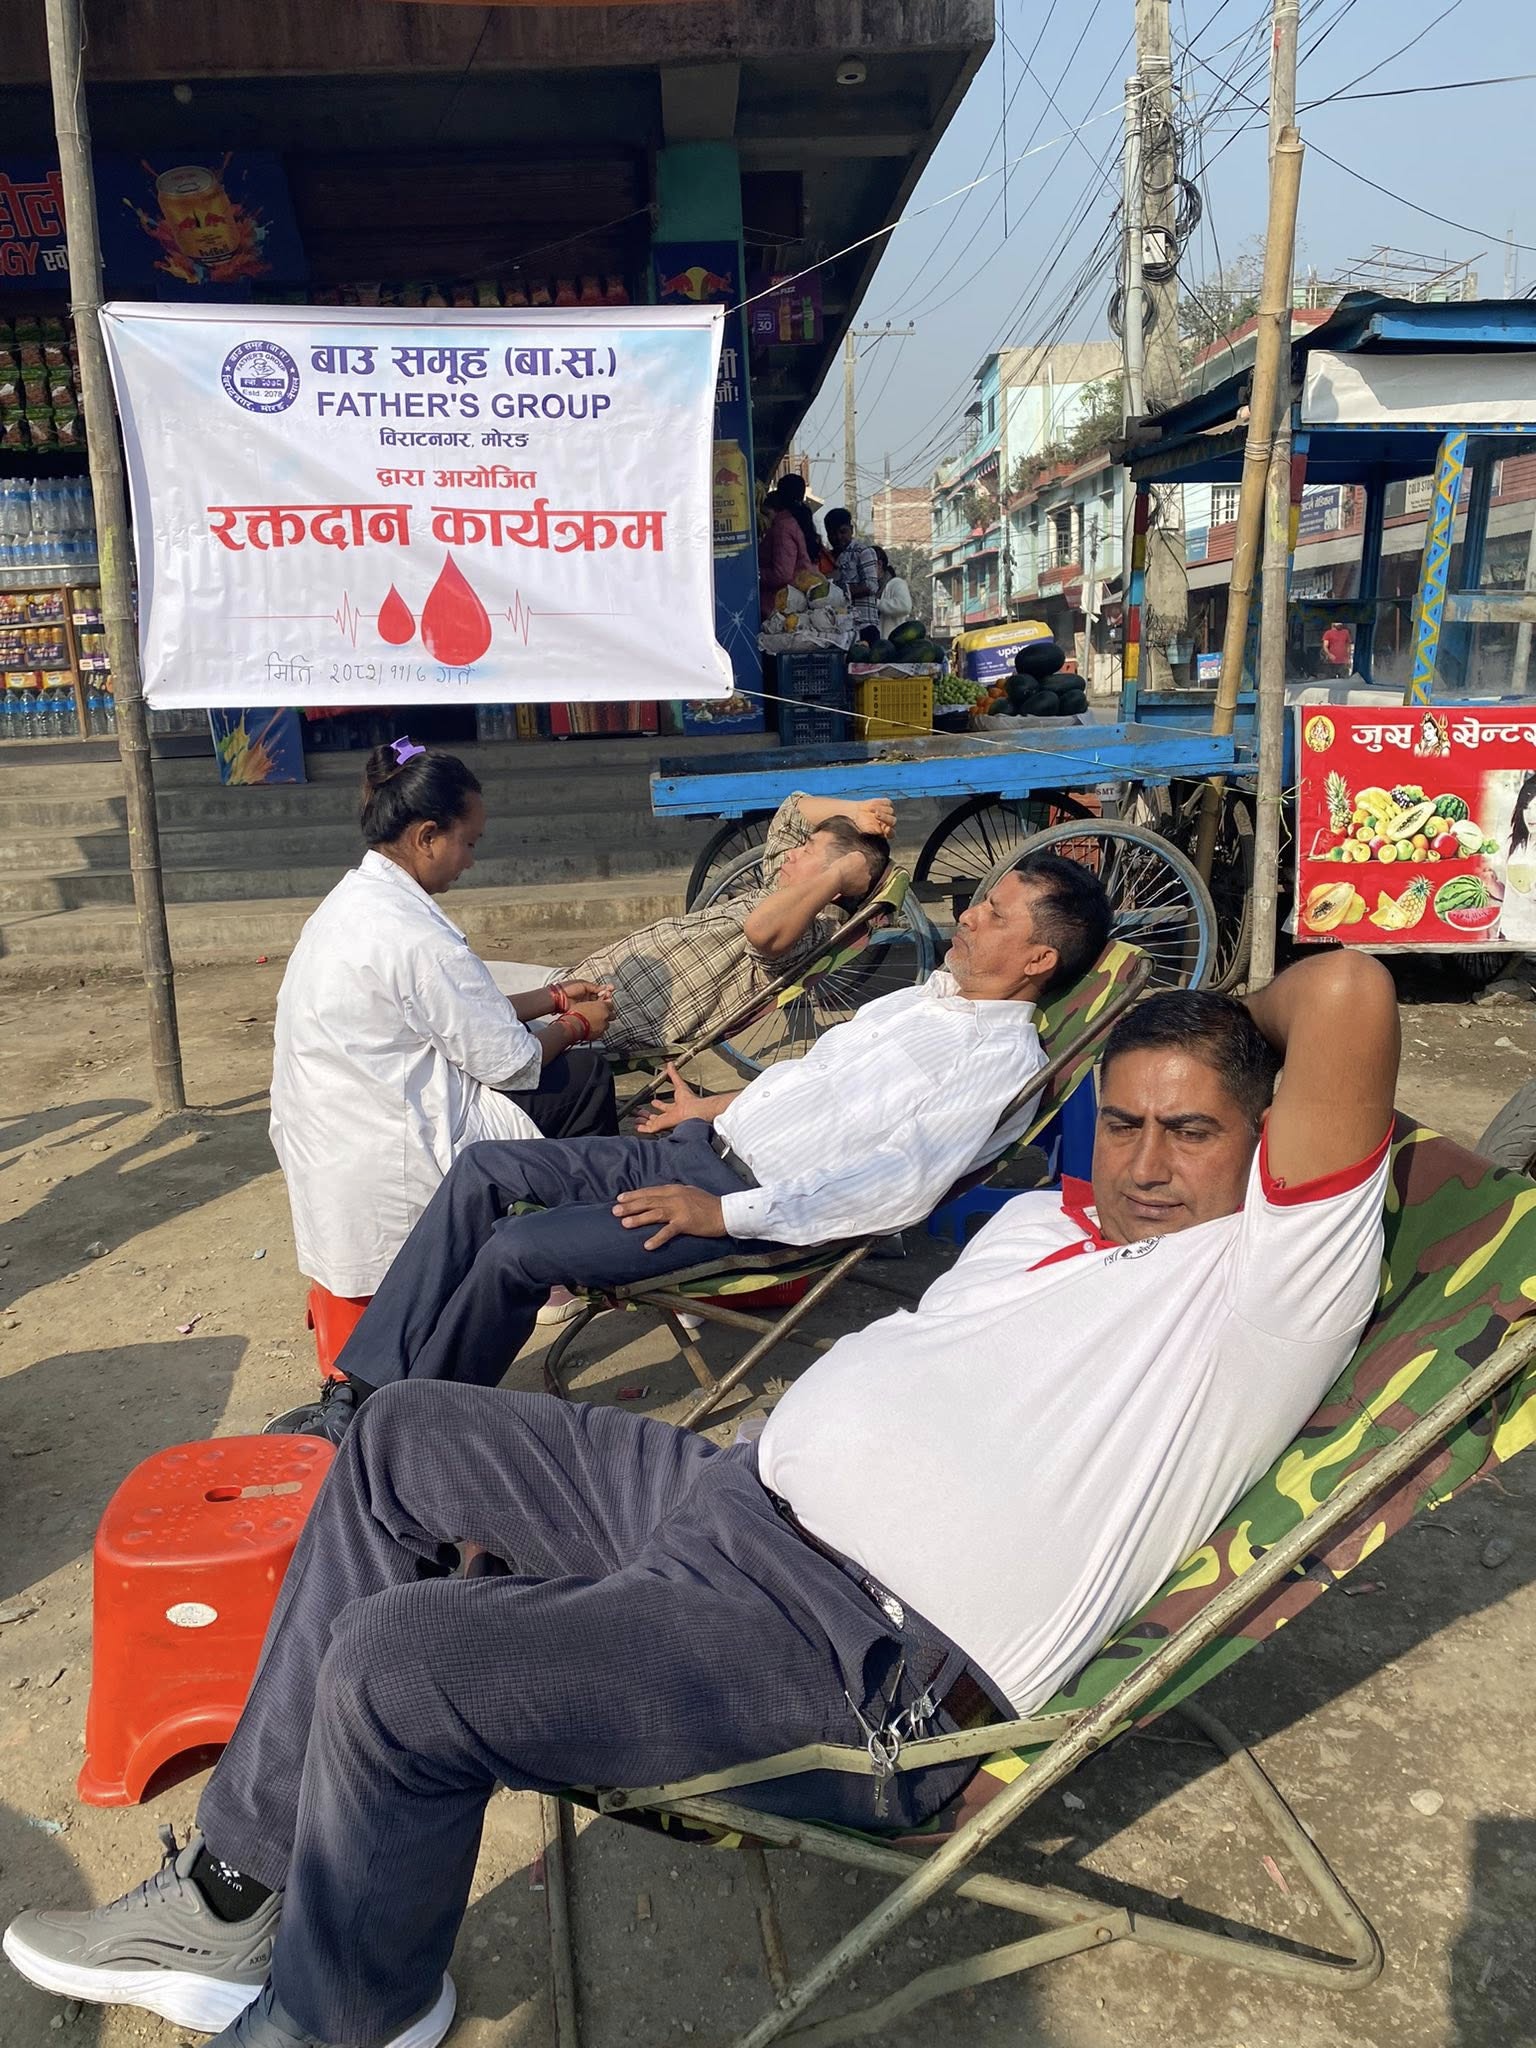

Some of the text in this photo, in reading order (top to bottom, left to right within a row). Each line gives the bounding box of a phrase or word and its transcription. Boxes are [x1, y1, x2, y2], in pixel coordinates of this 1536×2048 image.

[757, 320, 772, 331] 30
[236, 352, 286, 372] FATHER'S GROUP
[311, 345, 617, 385] बाउ समूह (बा.स.)
[264, 390, 283, 398] 2078
[317, 391, 611, 419] FATHER'S GROUP
[379, 427, 529, 448] विराटनगर, मोरङ
[376, 464, 538, 489] द्वारा आयोजित
[207, 497, 667, 553] रक्तदान कार्यक्रम
[264, 651, 314, 684] मिति
[1352, 724, 1415, 753] जुस
